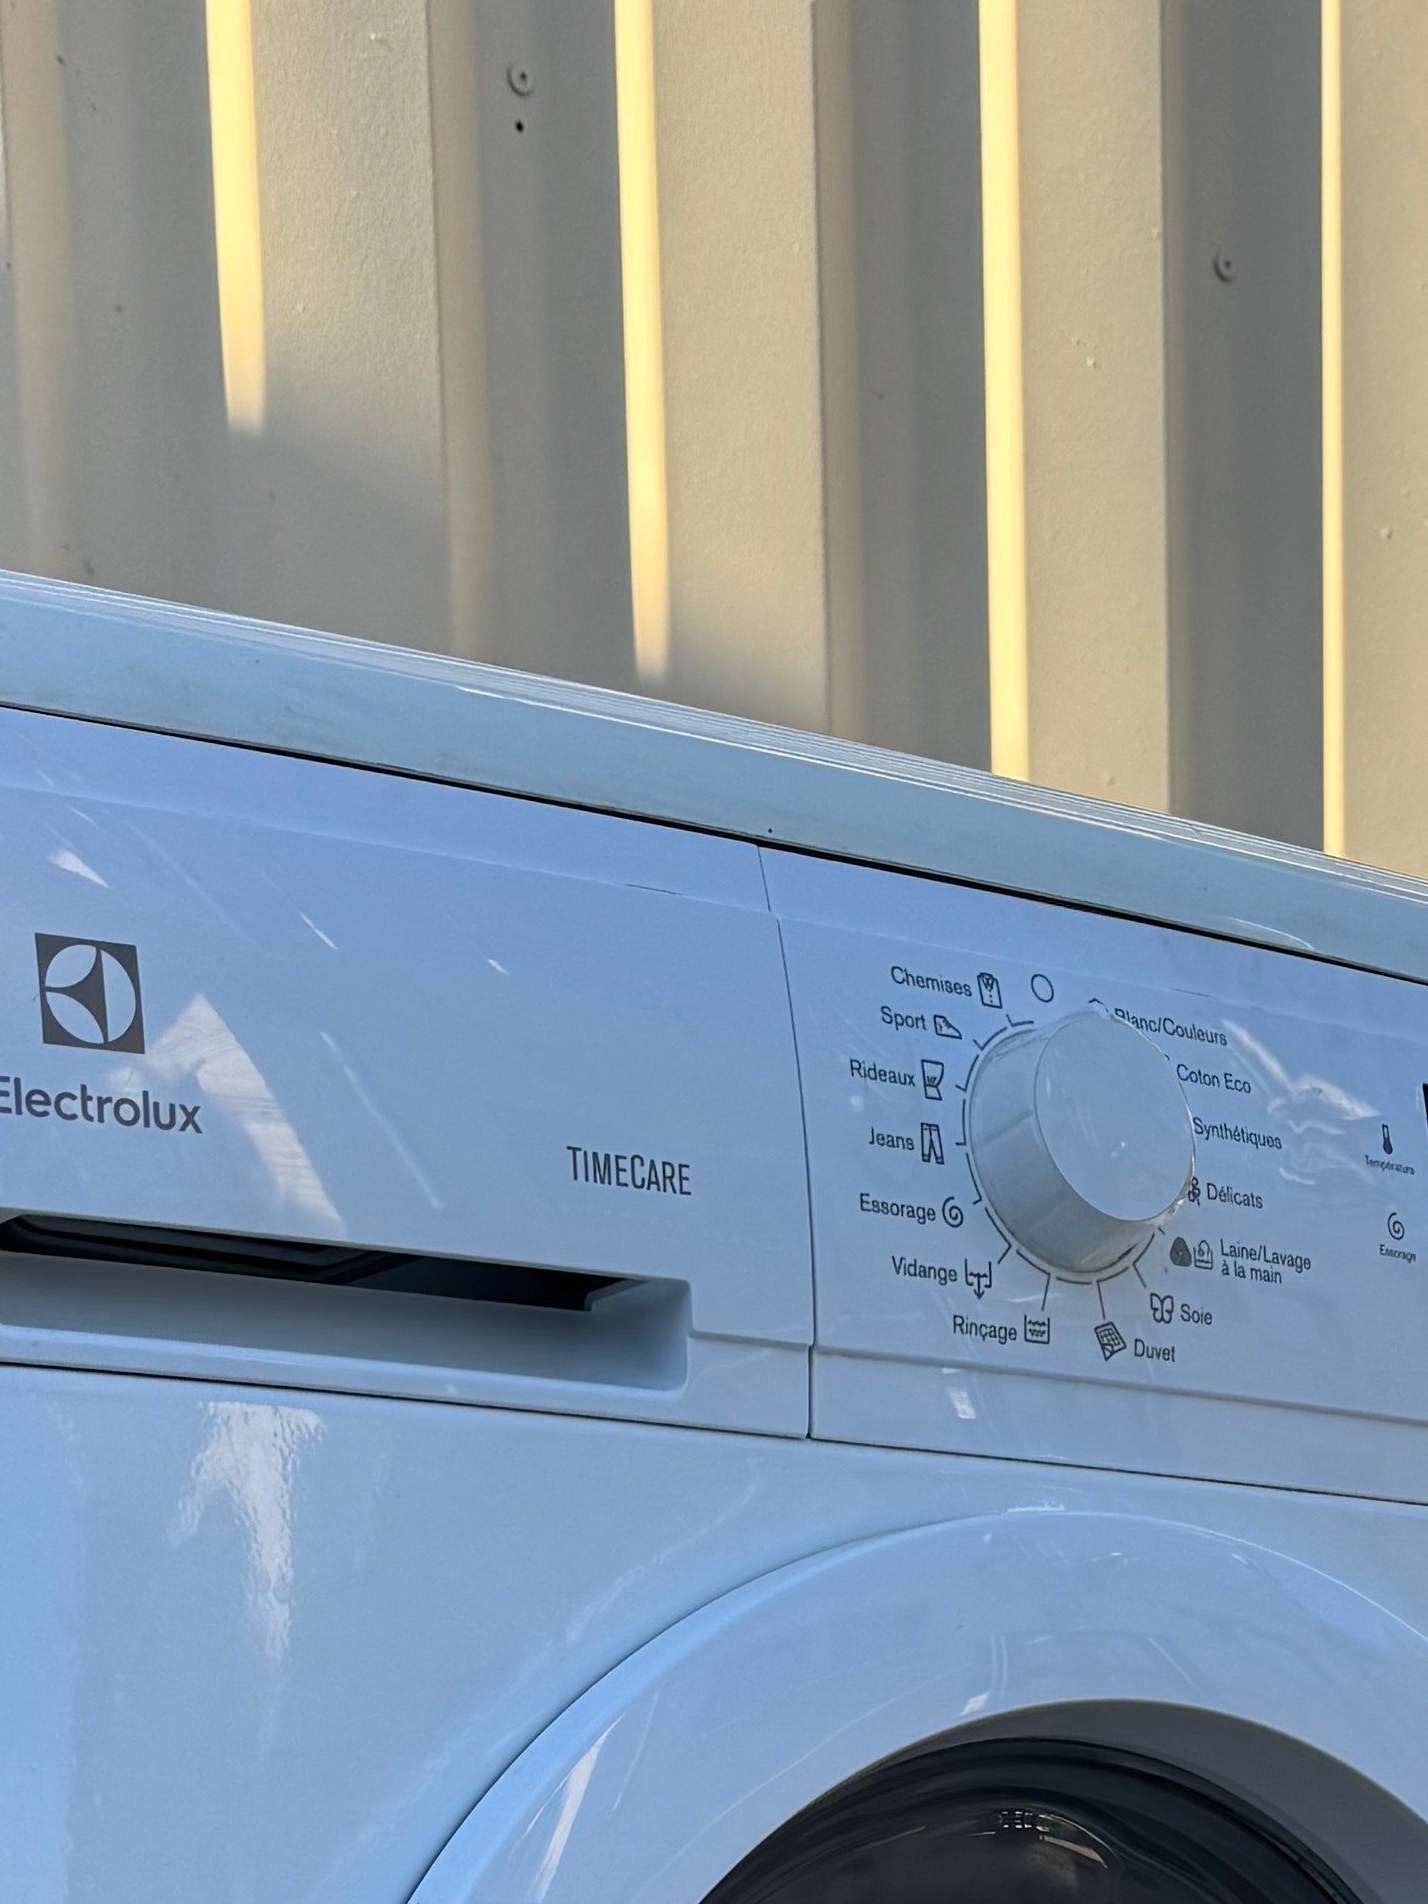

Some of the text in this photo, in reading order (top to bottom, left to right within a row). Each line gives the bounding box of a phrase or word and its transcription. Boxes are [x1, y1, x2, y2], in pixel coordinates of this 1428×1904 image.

[890, 965, 972, 997] Chemises
[880, 1005, 928, 1031] Sport
[849, 1058, 916, 1087] Rideaux
[1176, 1063, 1252, 1094] Coton Eco
[868, 1126, 915, 1151] Jeans
[1192, 1116, 1283, 1150] Synthétiques
[566, 1145, 693, 1196] TIMECARE
[860, 1192, 936, 1225] Essorage
[1206, 1182, 1264, 1209] Délicats
[891, 1255, 958, 1286] Vidange
[1220, 1238, 1312, 1274] Laine/Lavage
[1221, 1259, 1283, 1285] à la main
[952, 1314, 1018, 1345] Rinçage
[1180, 1303, 1213, 1326] Soie
[1134, 1338, 1176, 1363] Duvet
